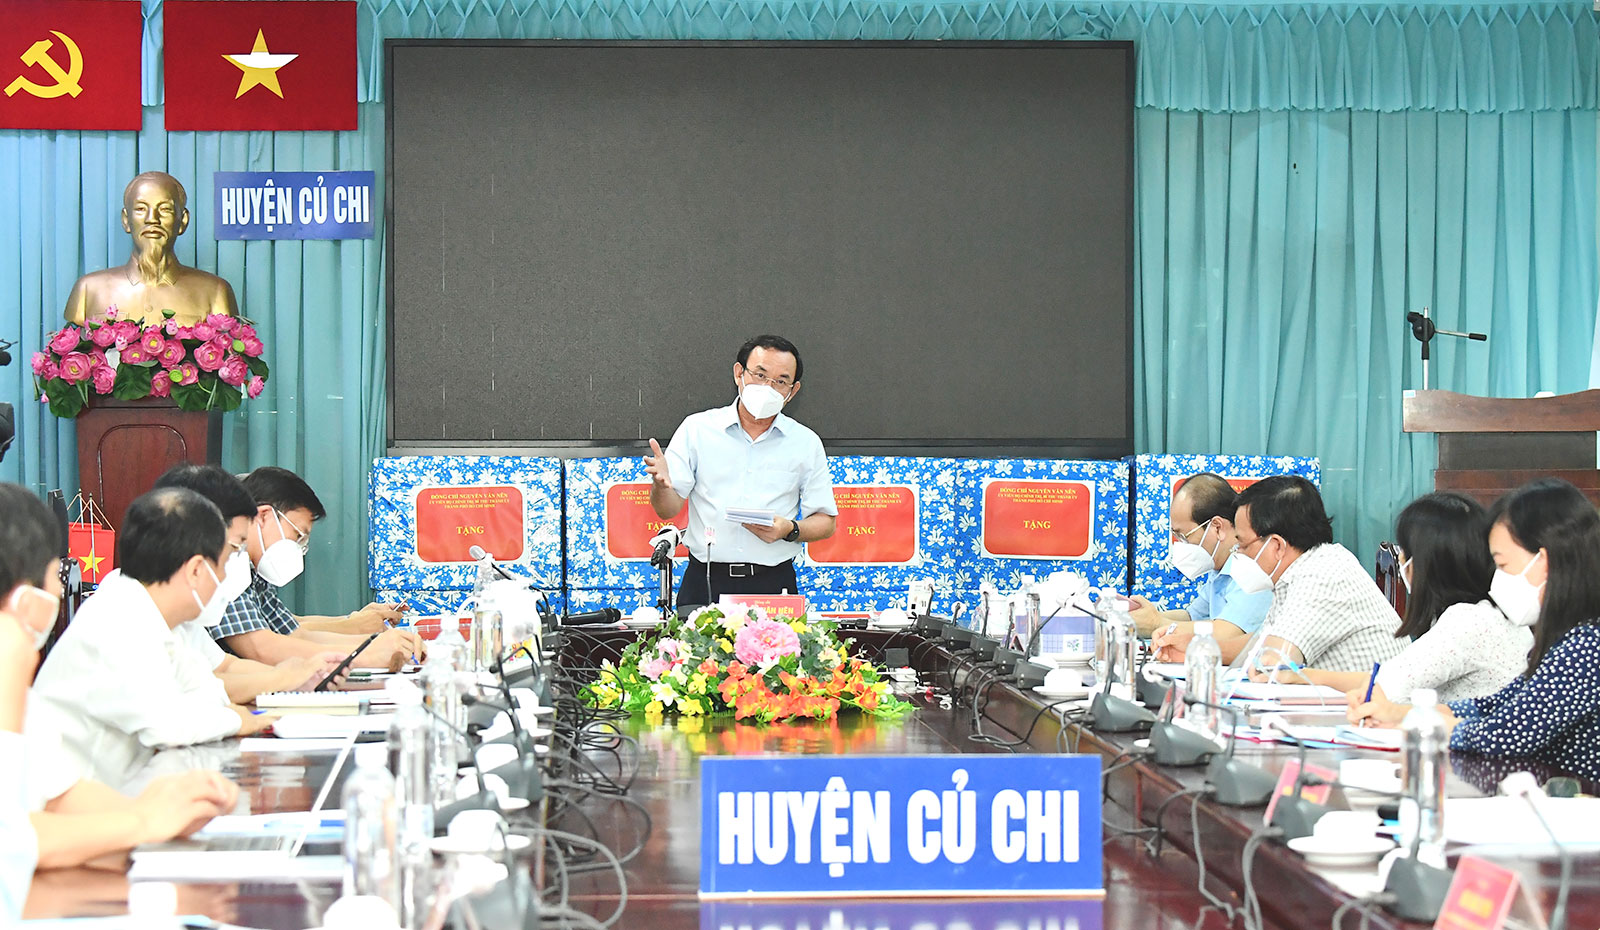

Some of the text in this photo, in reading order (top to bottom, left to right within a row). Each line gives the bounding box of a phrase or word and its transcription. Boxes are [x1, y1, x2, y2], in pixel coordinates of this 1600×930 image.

[222, 176, 370, 232] HUYỆN CỦ CHI
[1024, 520, 1051, 530] TẶNG
[456, 526, 484, 536] TẶNG
[847, 526, 876, 536] TẶNG
[718, 768, 1080, 878] HUYỆN CỦ CHI
